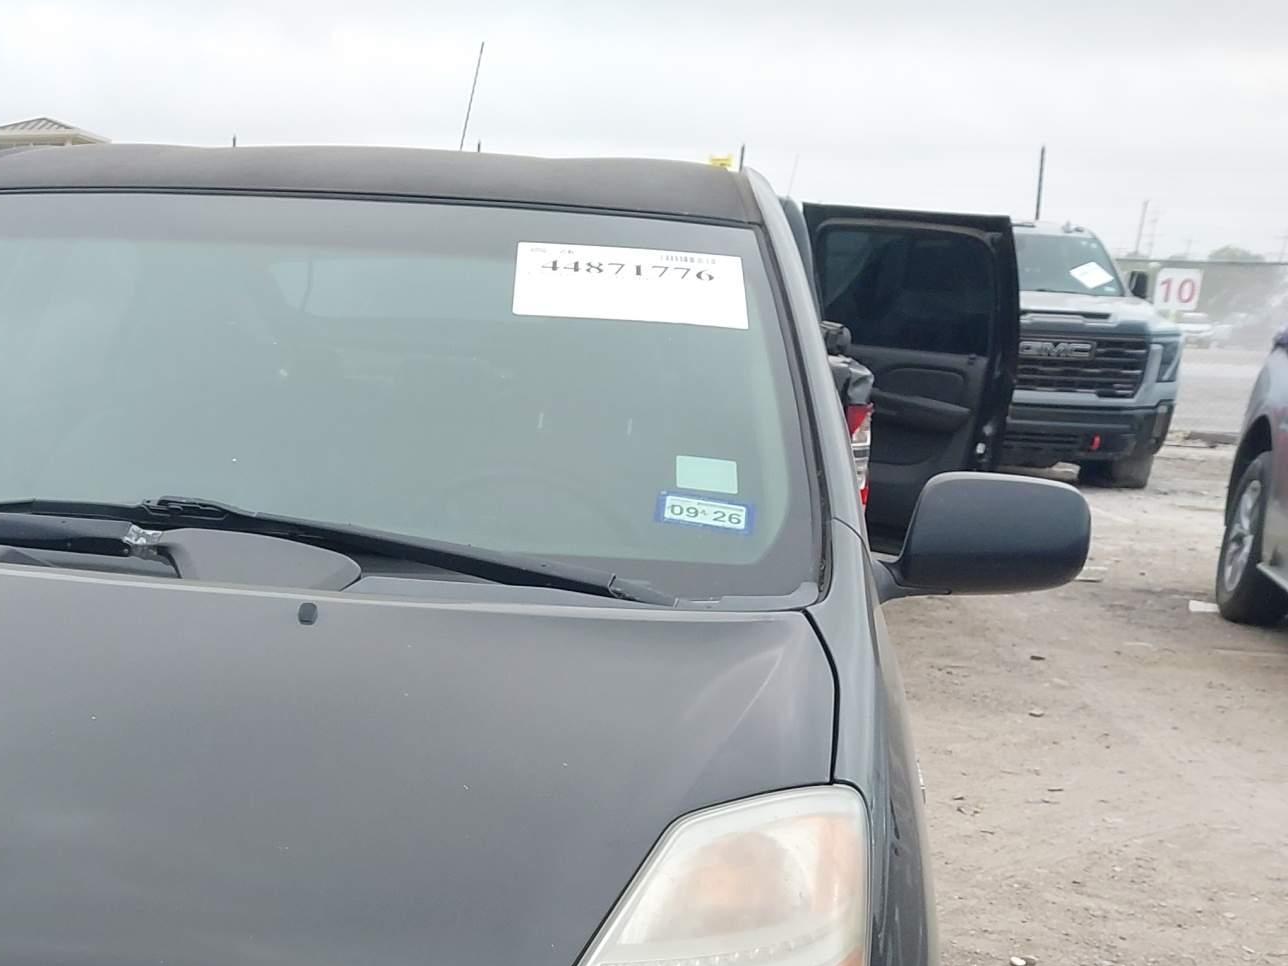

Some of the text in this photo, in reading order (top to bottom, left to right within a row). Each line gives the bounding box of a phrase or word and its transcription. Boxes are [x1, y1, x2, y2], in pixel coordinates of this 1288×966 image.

[541, 259, 715, 282] 44871776
[1159, 277, 1197, 304] 10
[1019, 341, 1093, 357] GMC
[670, 504, 699, 519] 09
[712, 510, 742, 525] 26
